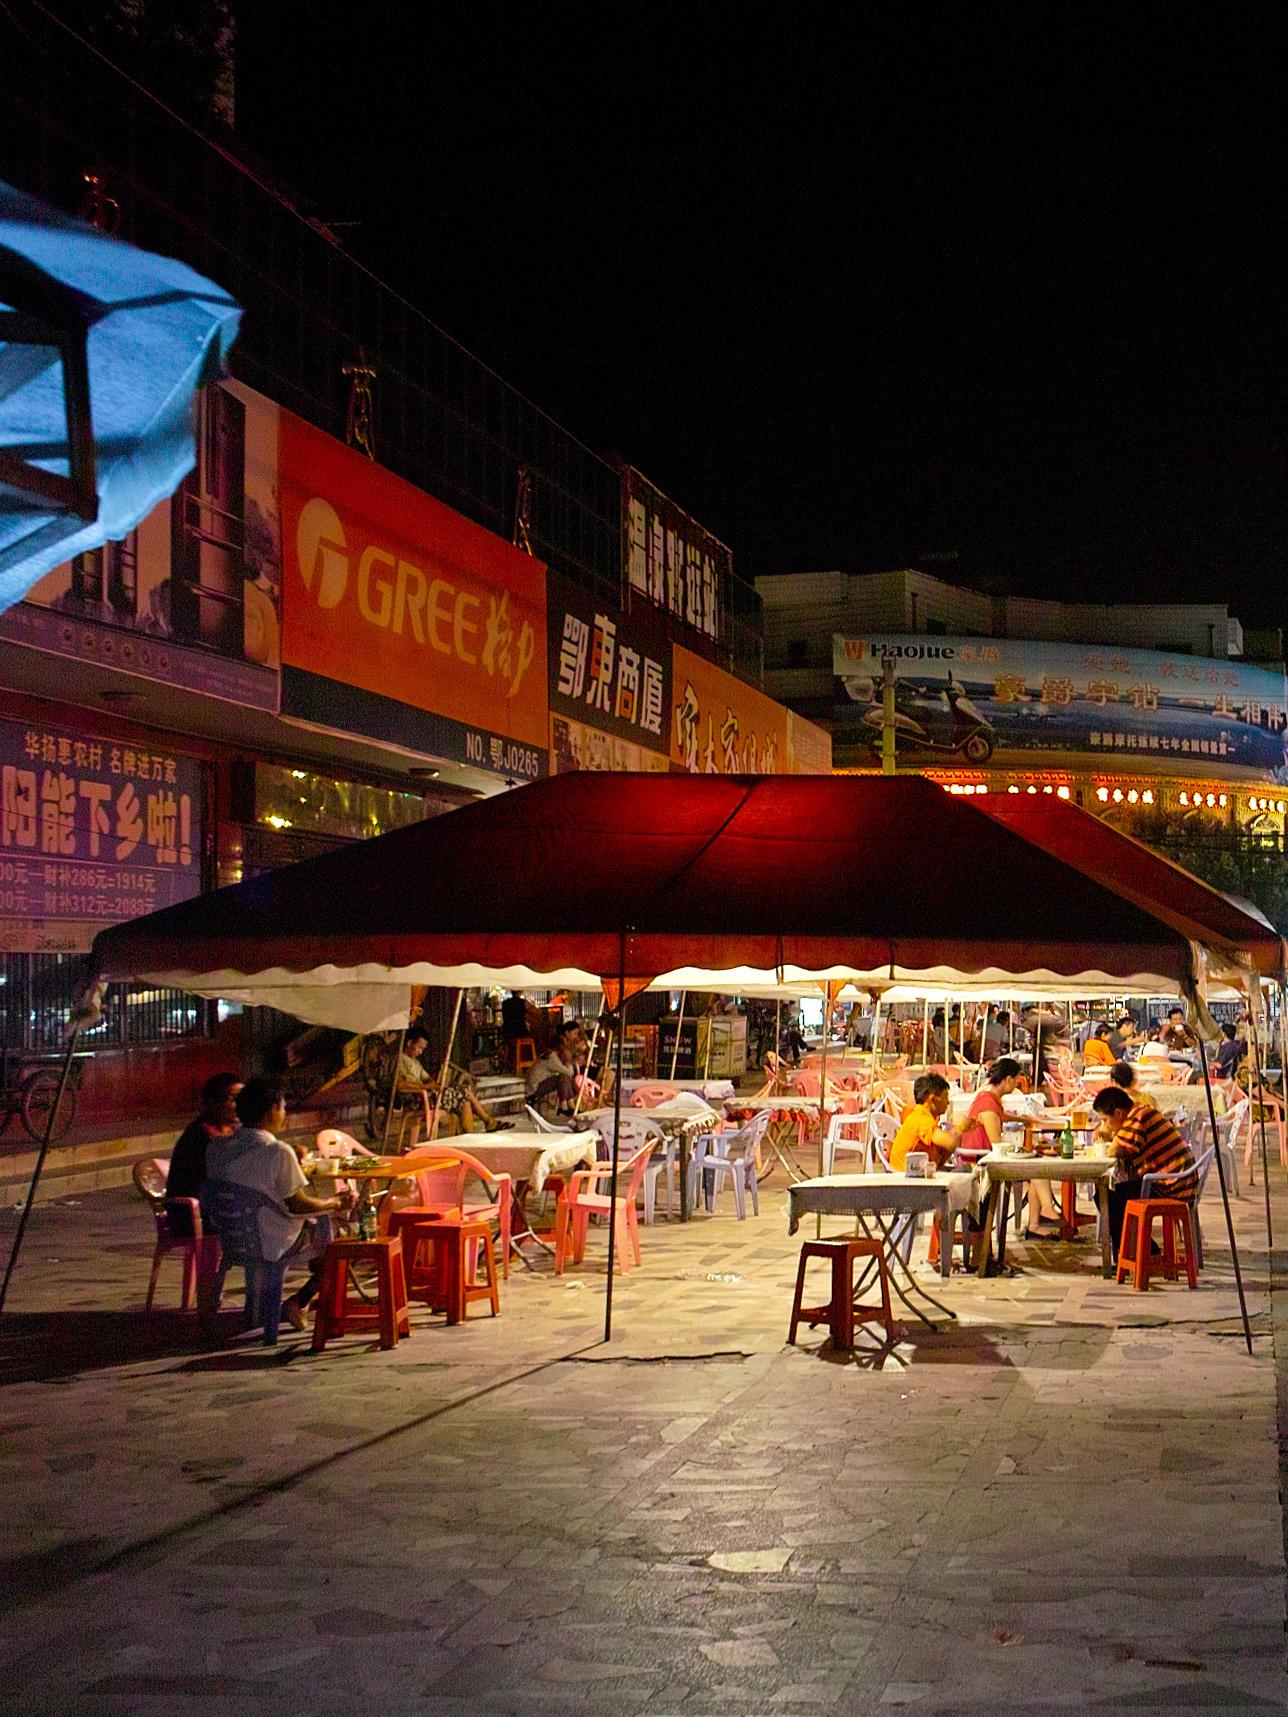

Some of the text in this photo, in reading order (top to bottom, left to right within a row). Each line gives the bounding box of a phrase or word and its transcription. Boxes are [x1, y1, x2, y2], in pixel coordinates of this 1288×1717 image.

[357, 544, 538, 699] GREE 格力
[870, 643, 955, 659] Haojue
[466, 731, 486, 764] NO.
